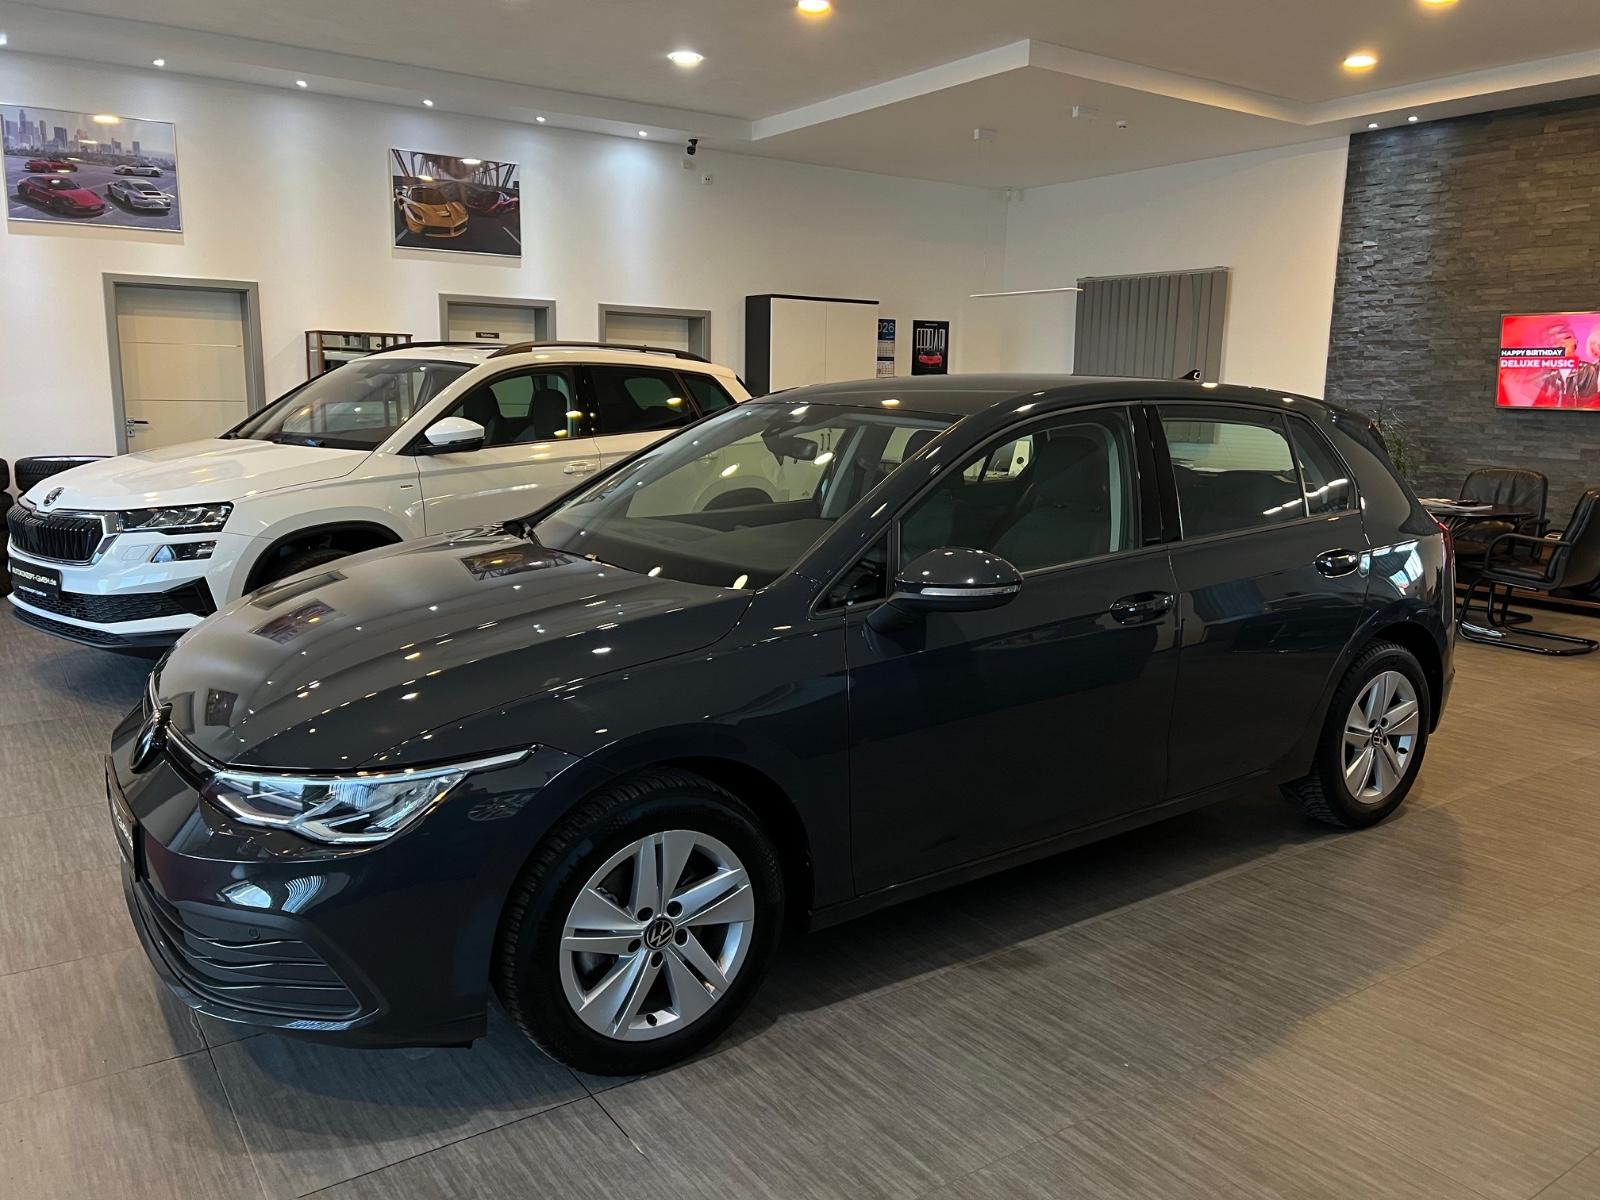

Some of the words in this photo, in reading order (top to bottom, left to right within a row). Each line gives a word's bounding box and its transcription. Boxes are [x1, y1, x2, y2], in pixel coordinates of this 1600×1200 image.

[878, 322, 895, 333] 026
[1500, 359, 1540, 368] DELUXE
[1541, 359, 1574, 368] MUSIC
